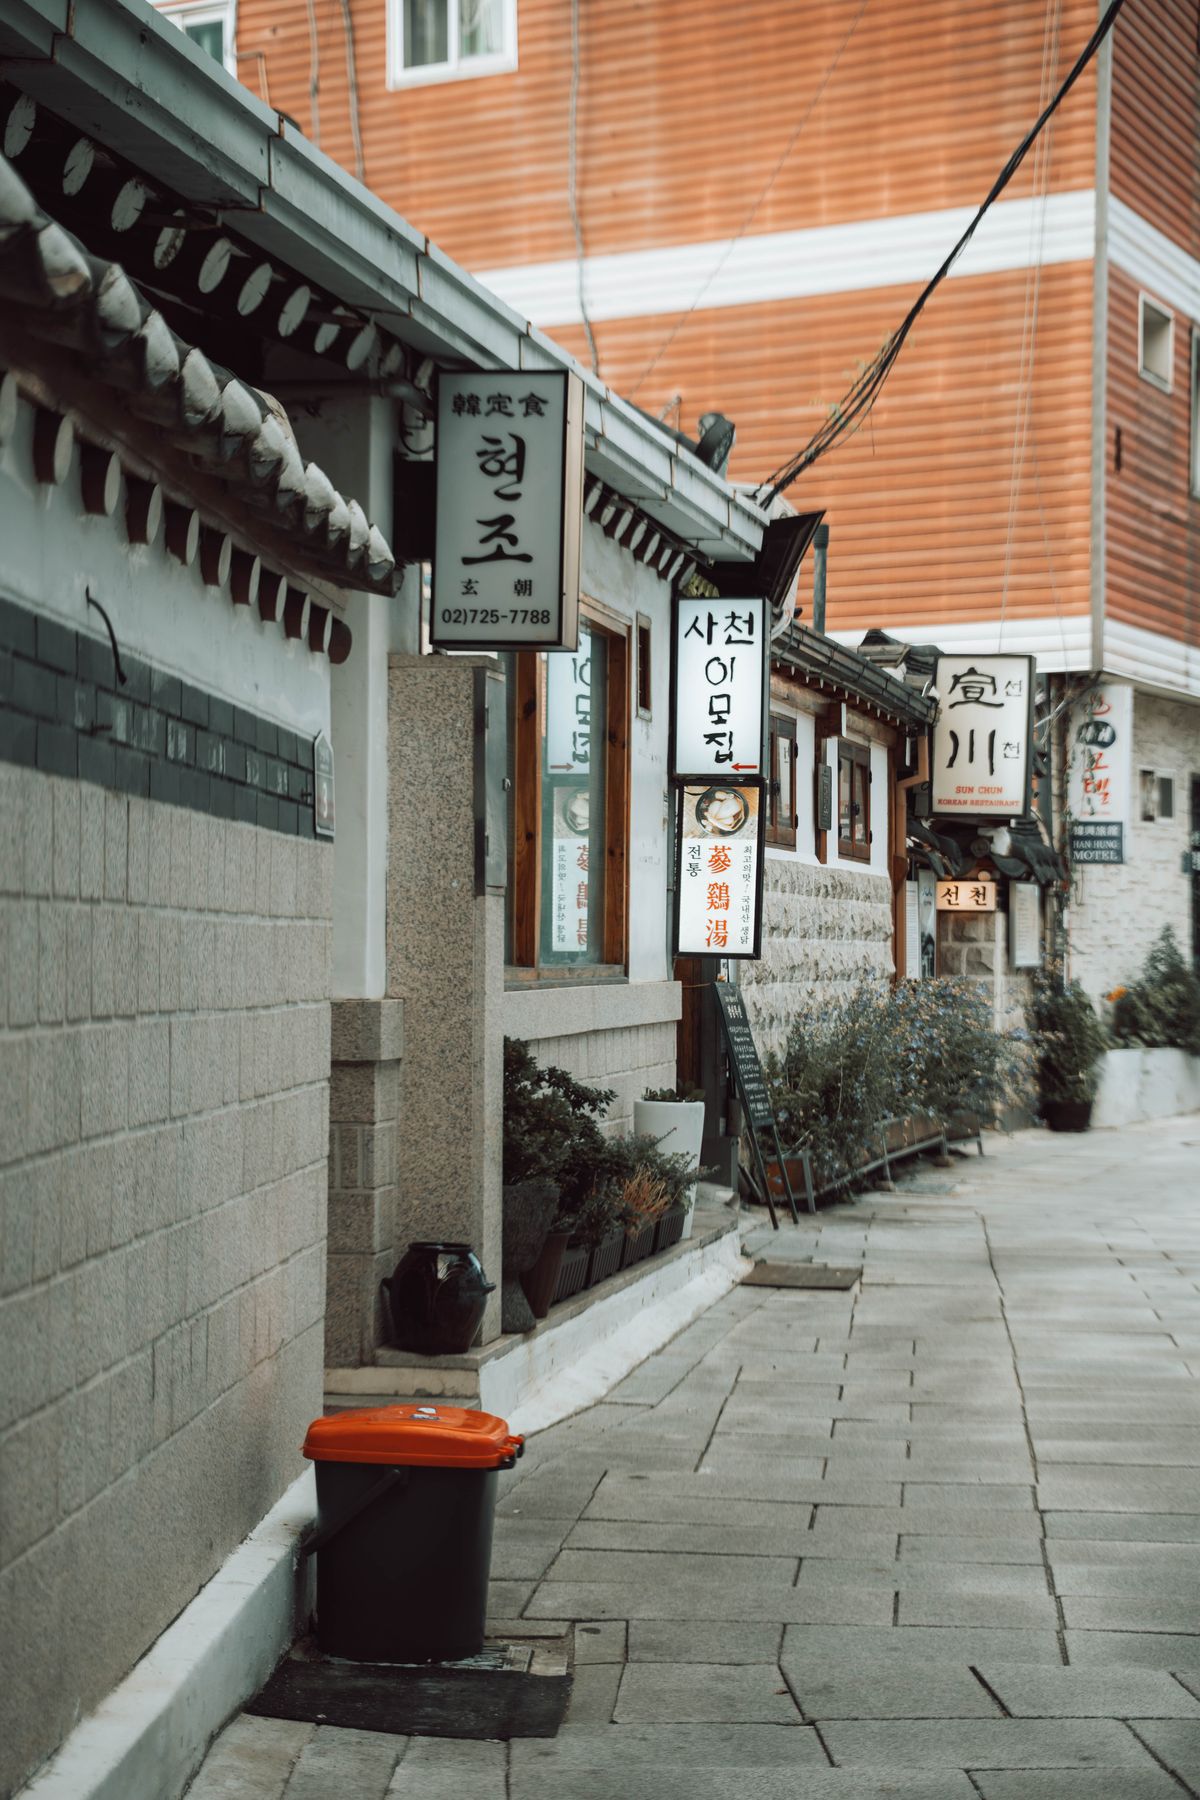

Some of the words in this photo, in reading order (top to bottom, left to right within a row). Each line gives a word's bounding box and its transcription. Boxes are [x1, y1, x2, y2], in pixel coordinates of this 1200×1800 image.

[452, 391, 549, 418] 韓定食
[461, 432, 533, 565] 현조
[441, 608, 551, 626] 02)725-7788
[684, 611, 755, 645] 사천
[946, 667, 1004, 776] 宣川
[956, 786, 974, 794] SUN
[978, 786, 1003, 794] CHUN
[937, 798, 967, 806] KOREAN
[1073, 840, 1091, 849] HAN
[1093, 840, 1118, 849] HUNG
[1073, 850, 1118, 860] MOTEL
[686, 845, 702, 877] 전통
